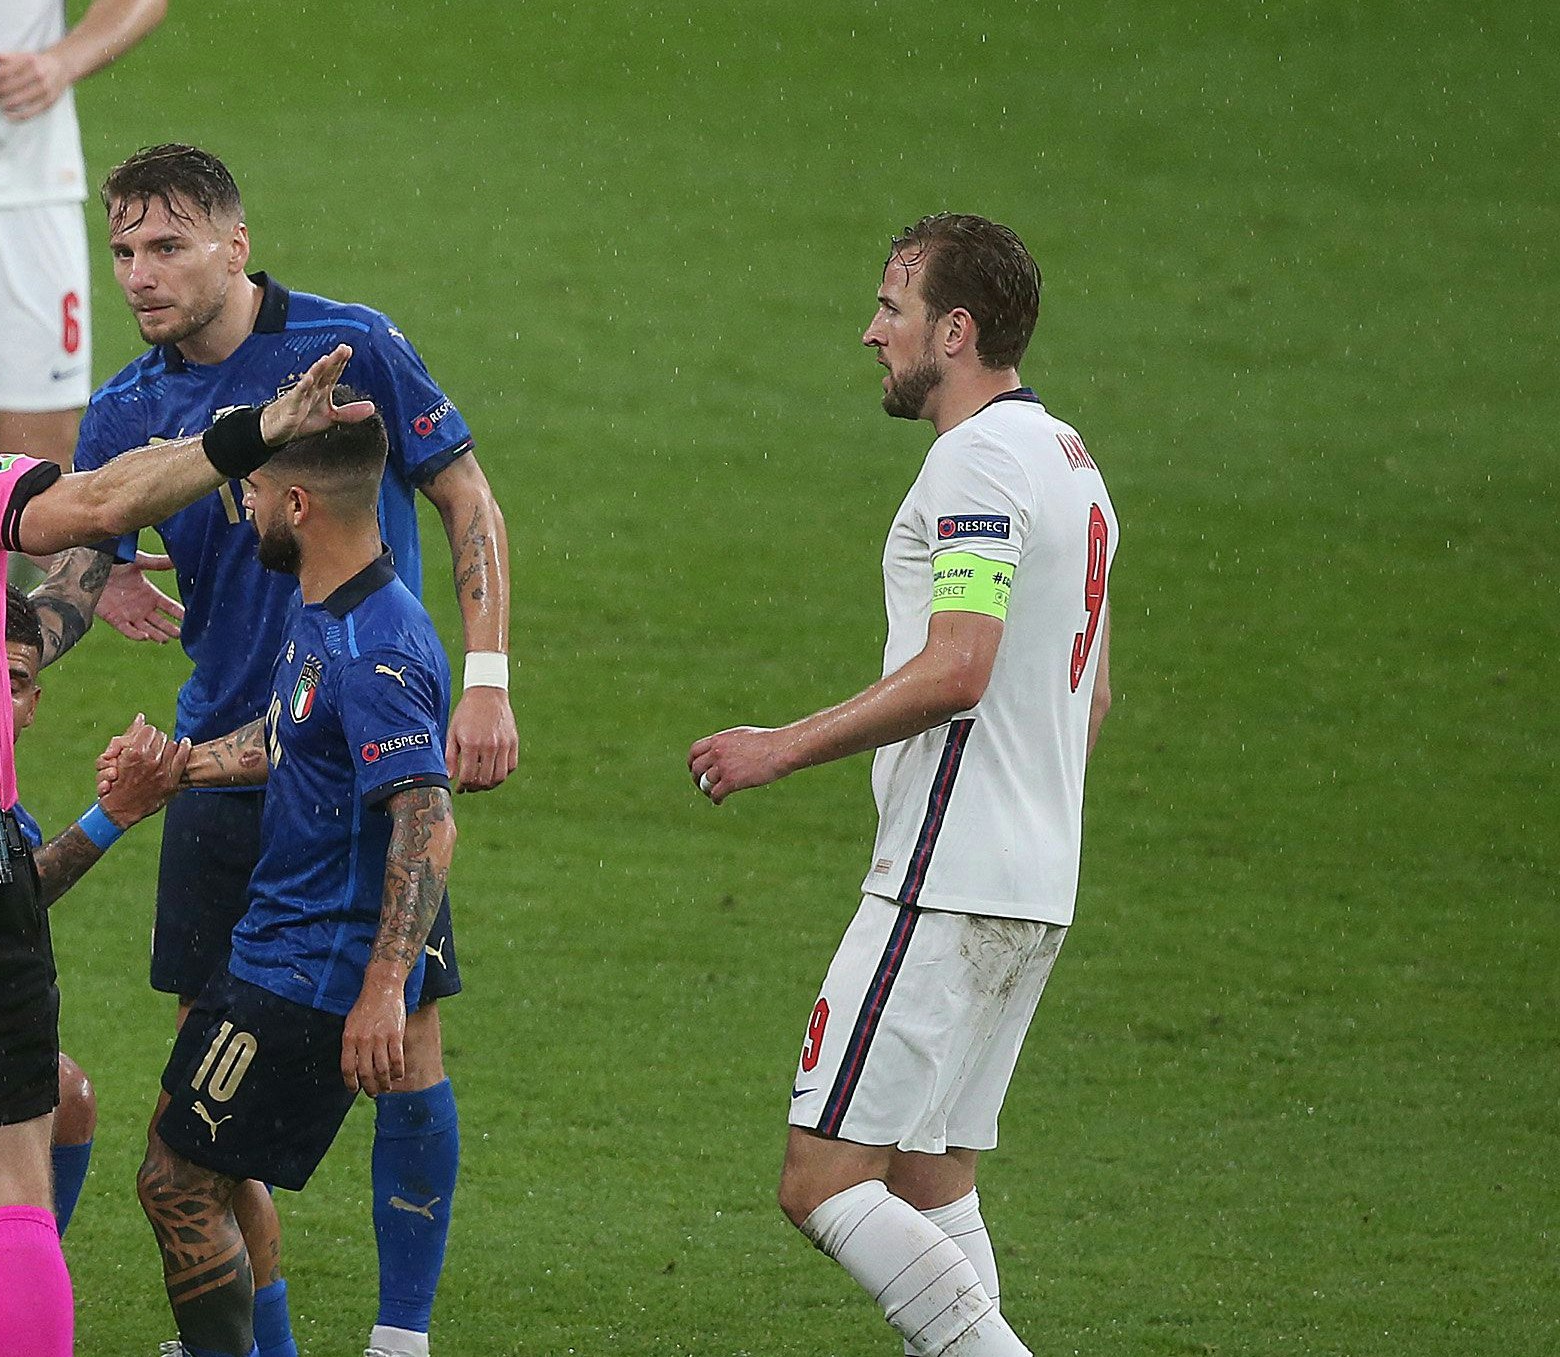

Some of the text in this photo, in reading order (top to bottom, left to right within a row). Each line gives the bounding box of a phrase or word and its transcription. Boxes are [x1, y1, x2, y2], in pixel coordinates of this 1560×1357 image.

[64, 292, 79, 354] 6
[957, 520, 1009, 533] RESPECT
[933, 585, 967, 598] ESPECT
[1070, 502, 1108, 694] 9
[379, 733, 430, 754] RESPECT
[190, 1020, 258, 1103] 10
[801, 997, 831, 1074] 9
